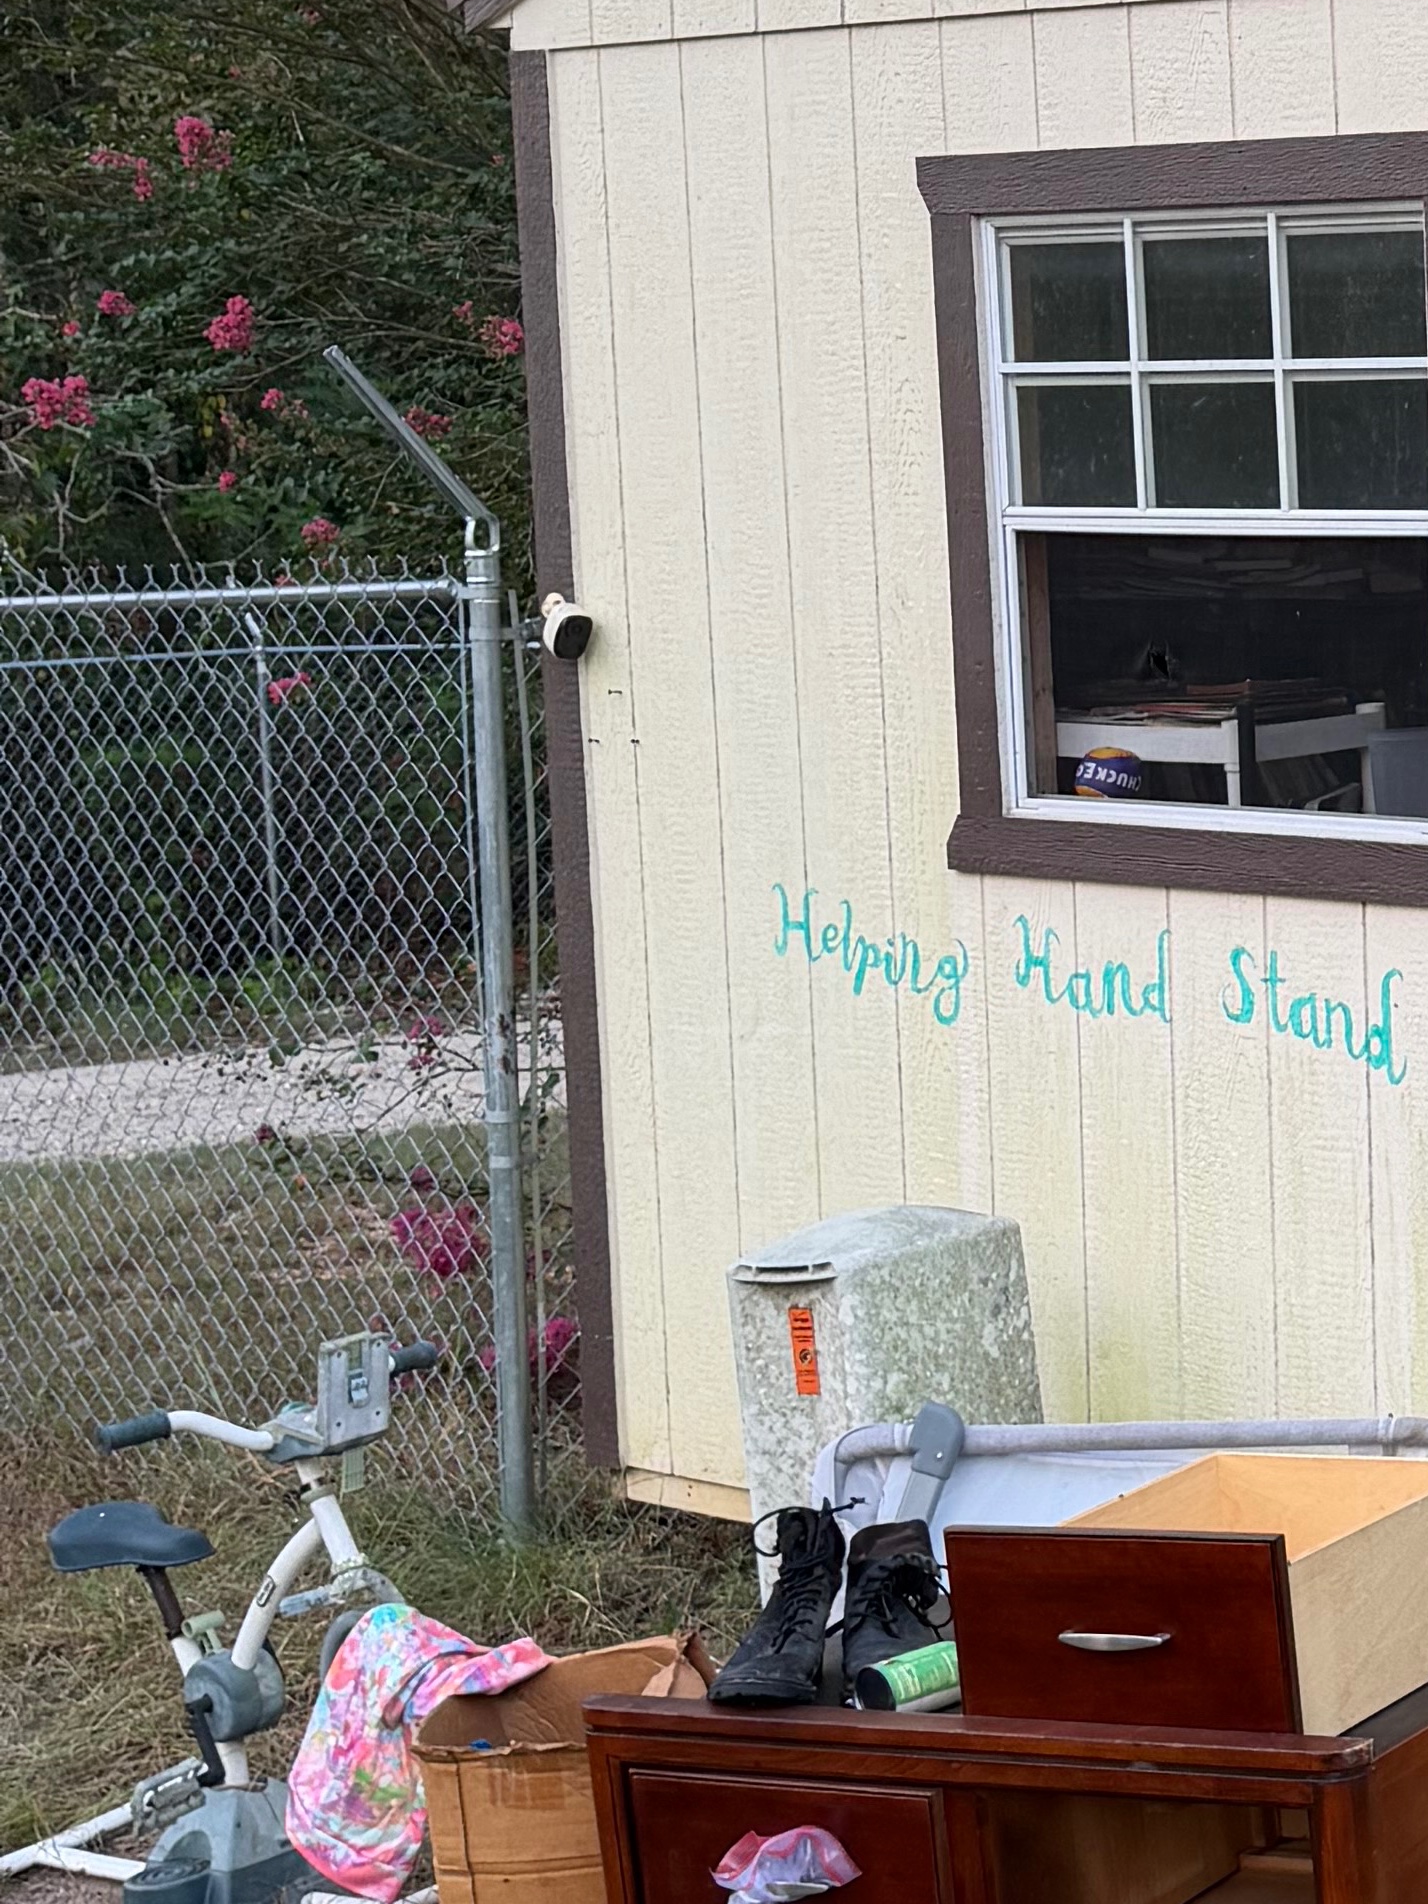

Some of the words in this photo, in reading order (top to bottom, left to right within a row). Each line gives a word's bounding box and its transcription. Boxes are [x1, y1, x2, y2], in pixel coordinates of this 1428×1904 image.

[773, 883, 969, 1026] Helping
[1015, 913, 1171, 1023] Hand
[1221, 946, 1407, 1087] Stand
